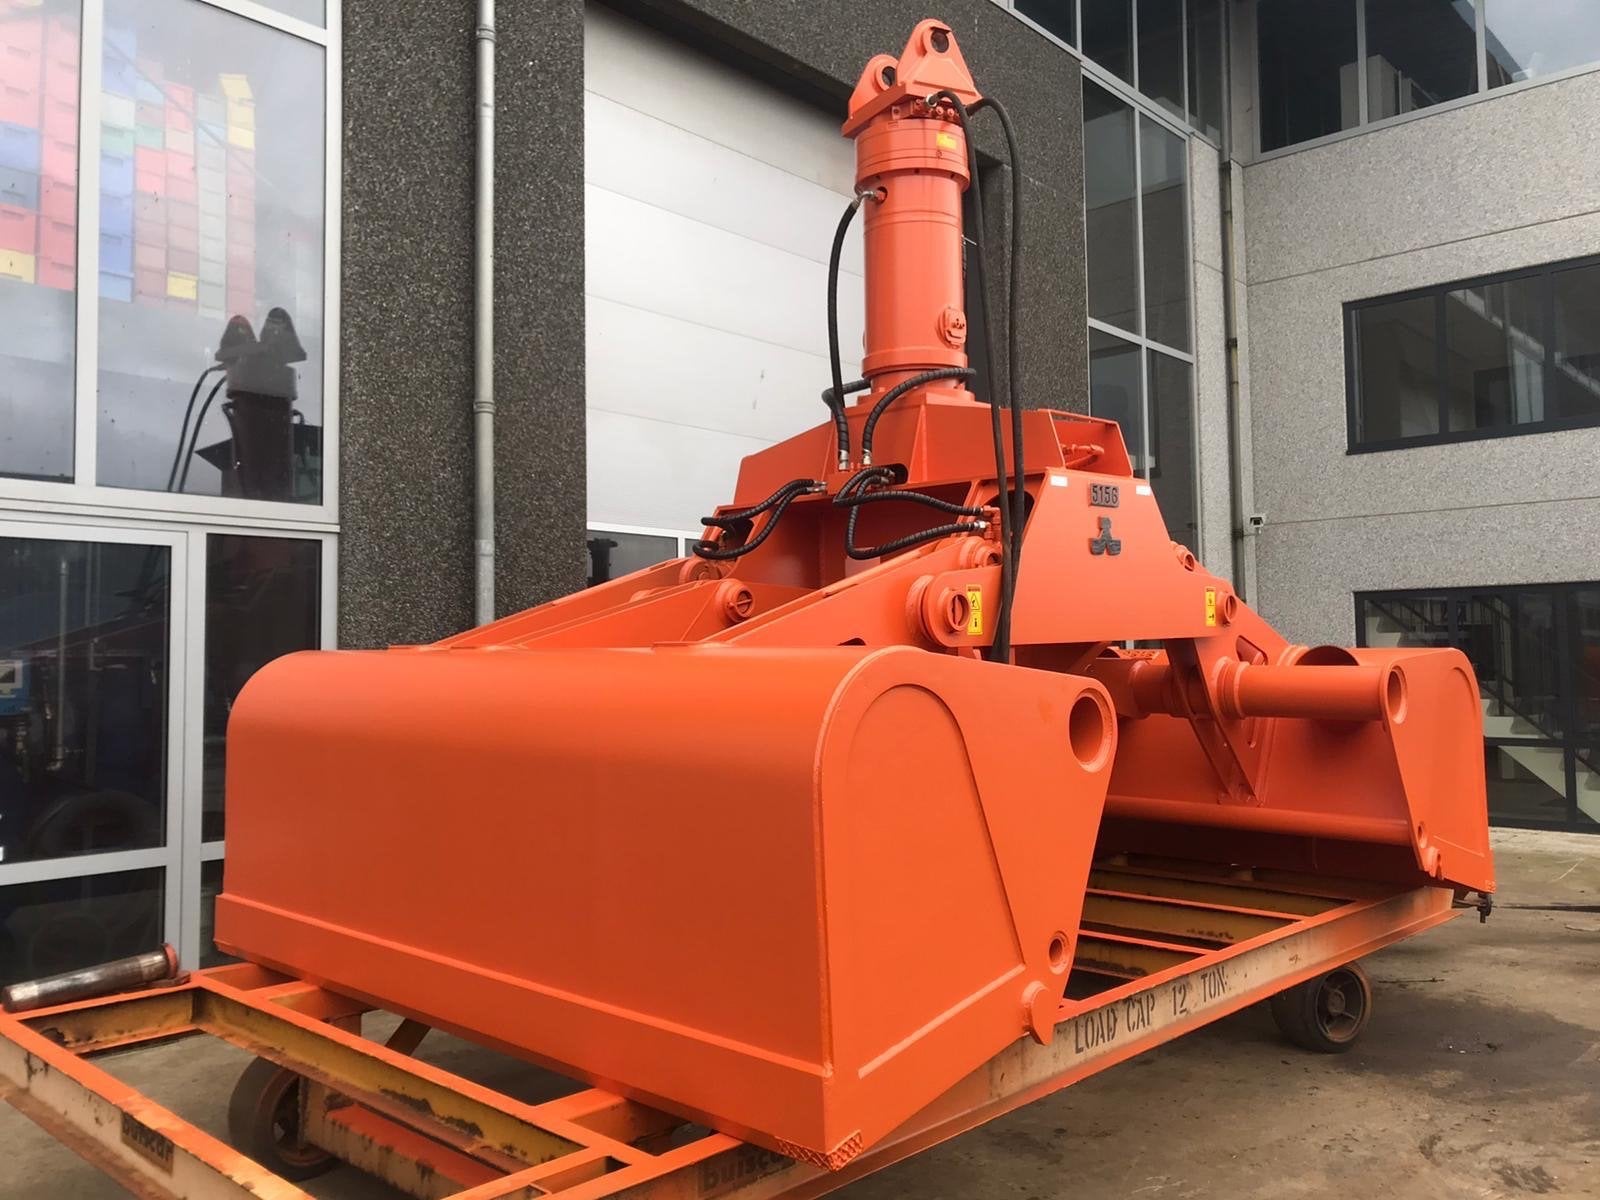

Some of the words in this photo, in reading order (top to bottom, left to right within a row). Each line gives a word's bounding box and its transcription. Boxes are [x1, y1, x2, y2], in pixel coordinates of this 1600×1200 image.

[1092, 485, 1119, 504] 5156
[1074, 1004, 1118, 1054] LOAD
[1126, 994, 1156, 1033] CAP
[1171, 984, 1188, 1016] 12
